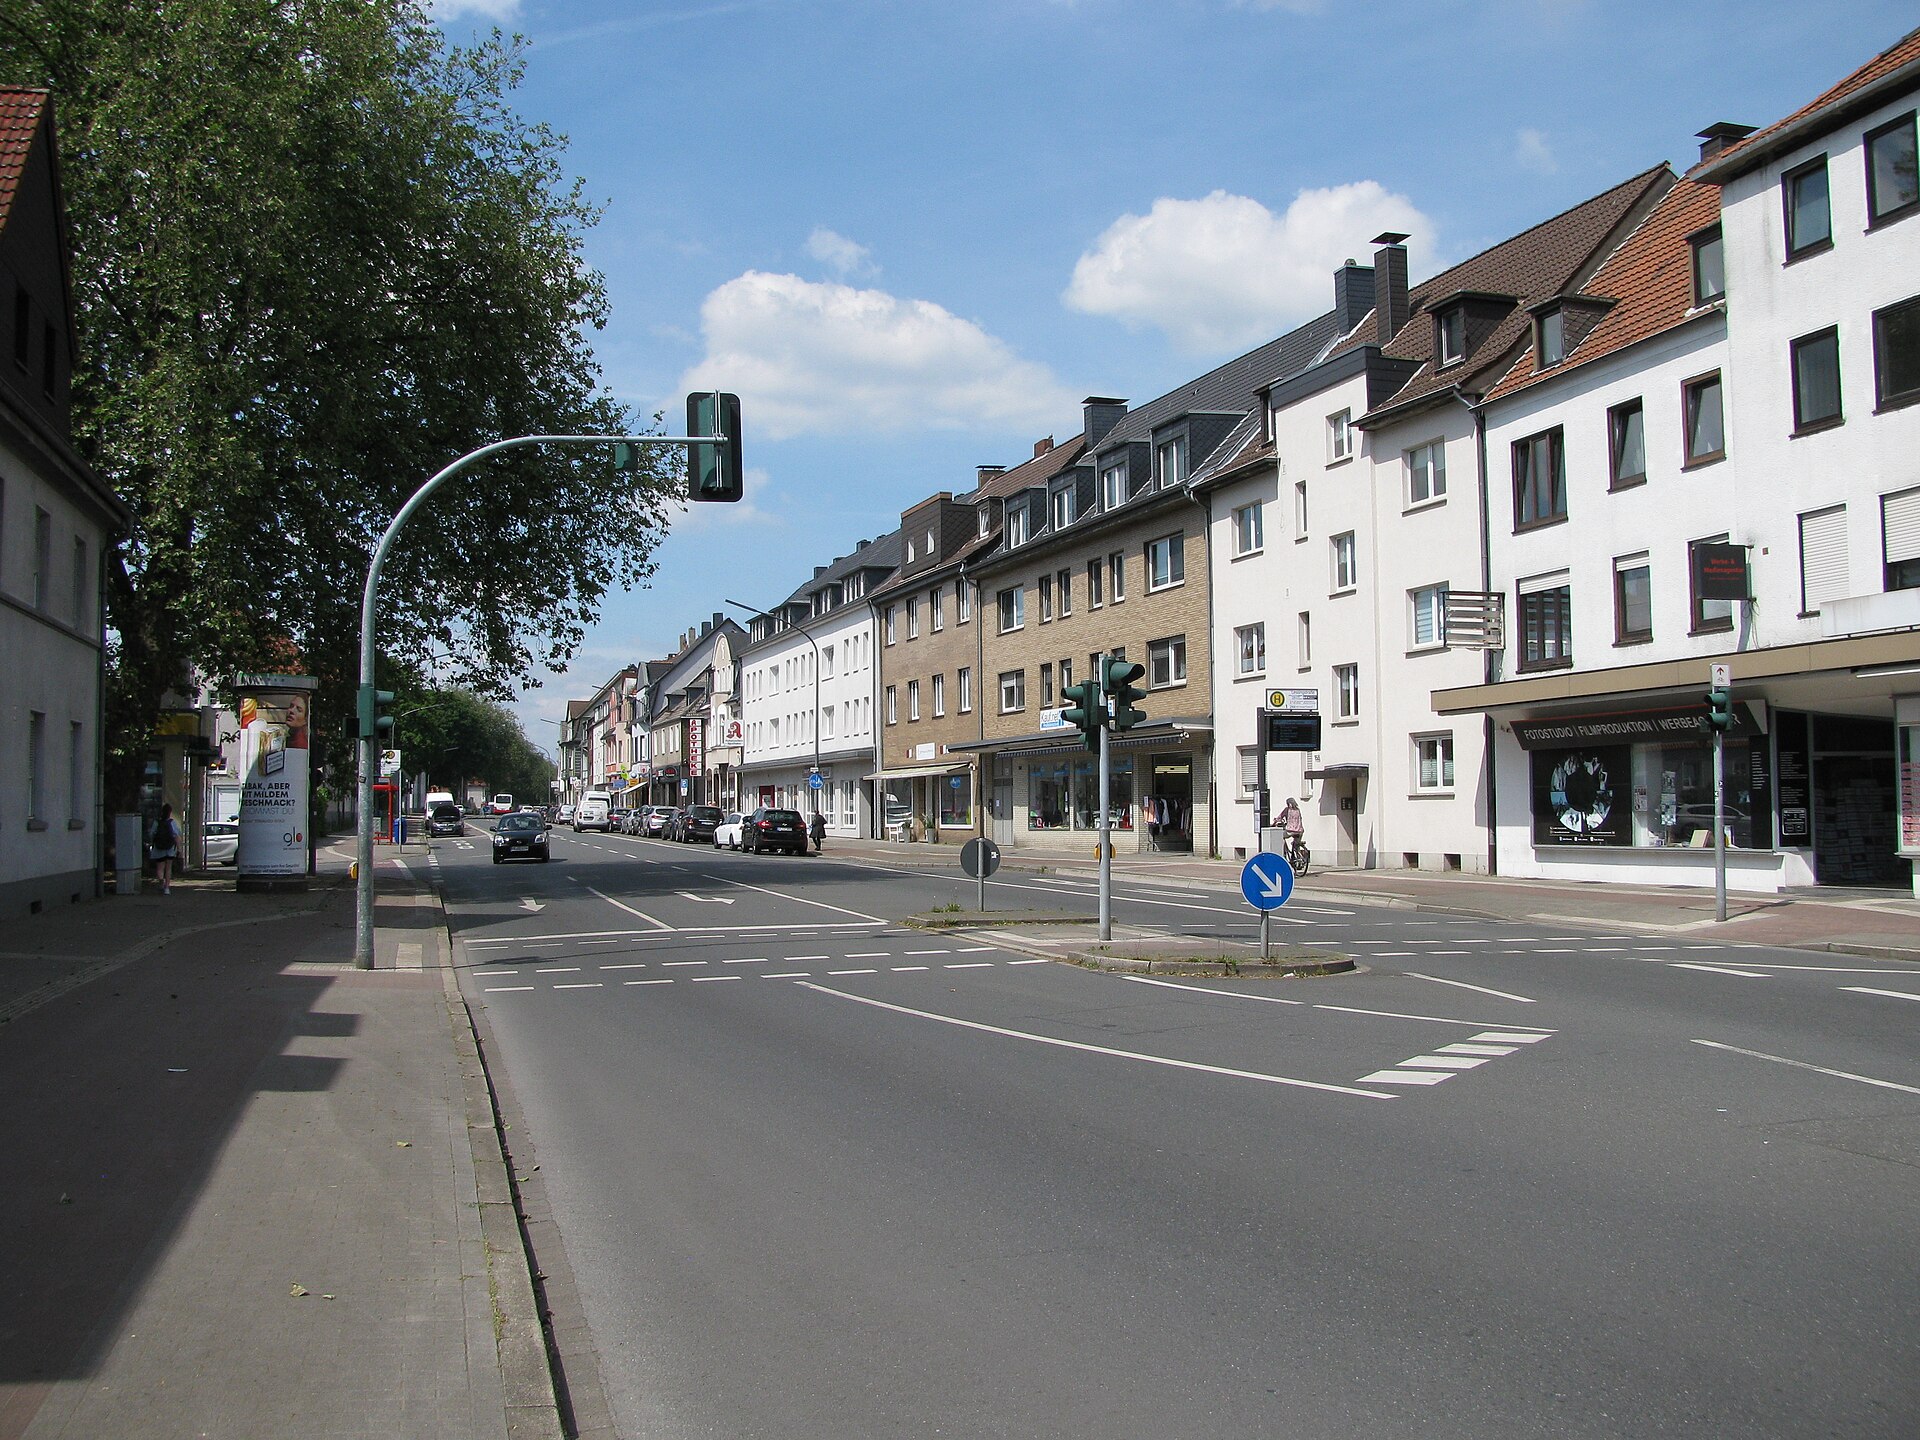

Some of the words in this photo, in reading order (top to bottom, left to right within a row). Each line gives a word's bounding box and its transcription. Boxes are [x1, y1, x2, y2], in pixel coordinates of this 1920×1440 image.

[1523, 726, 1574, 740] FOTOSTUDIO
[1577, 719, 1653, 736] FILMPRODUKTION
[690, 719, 698, 776] APOTHEKE
[267, 782, 290, 790] ABER
[253, 790, 289, 798] MILDEM
[283, 826, 303, 847] glo
